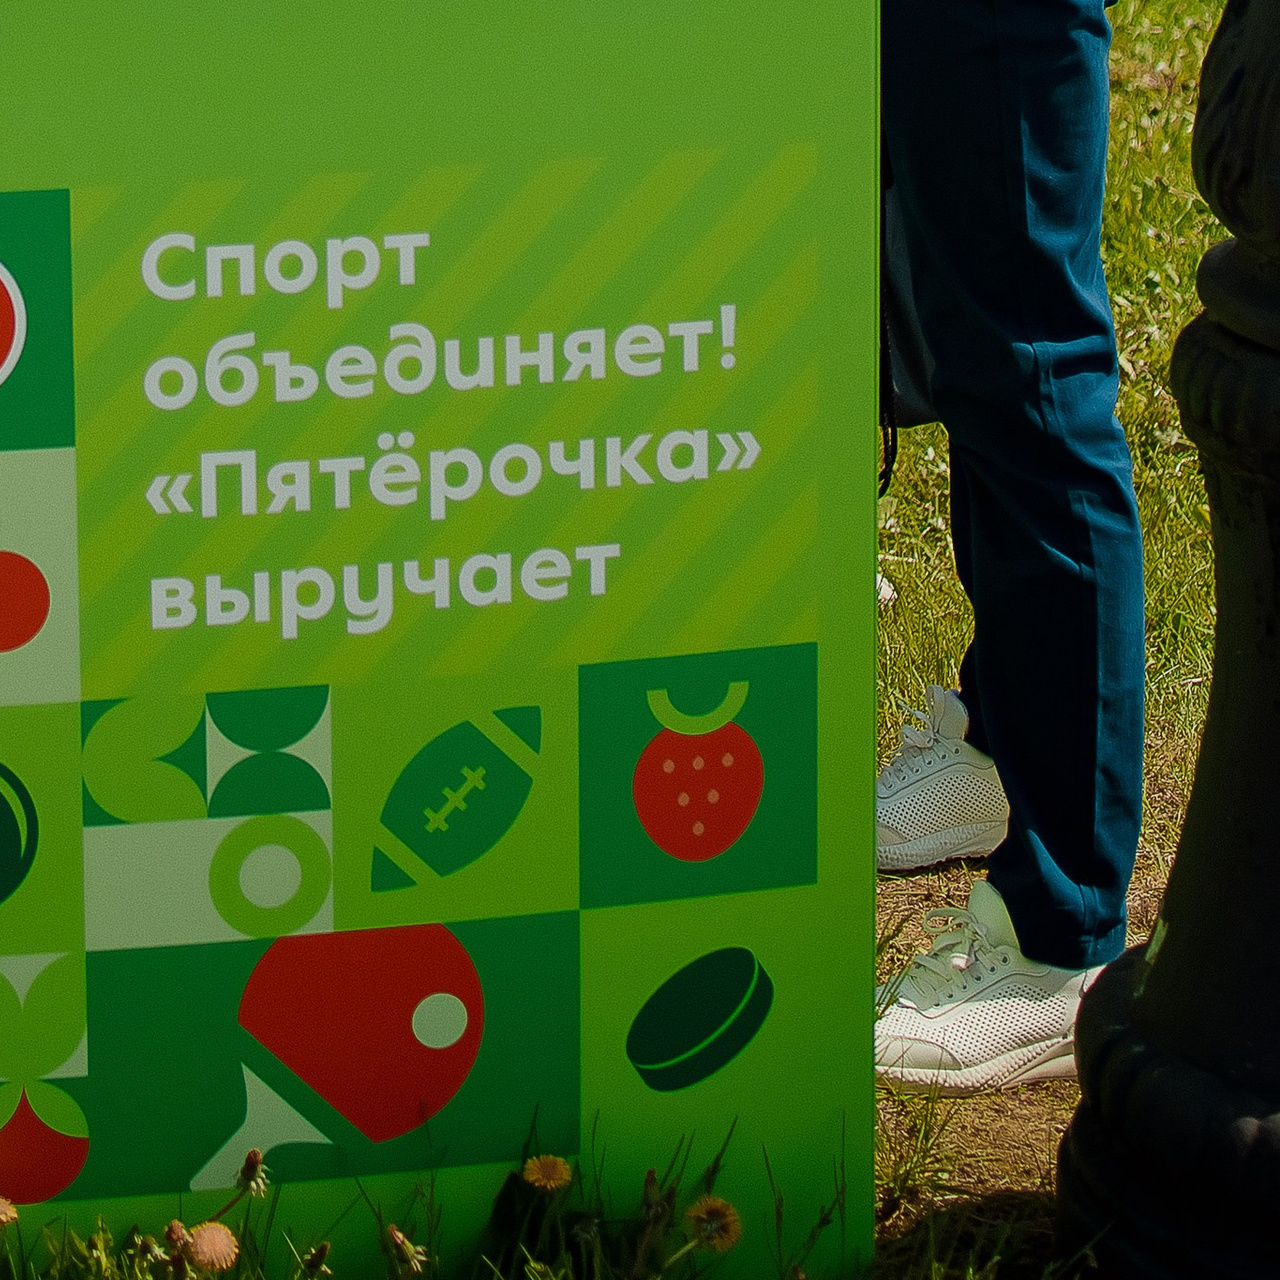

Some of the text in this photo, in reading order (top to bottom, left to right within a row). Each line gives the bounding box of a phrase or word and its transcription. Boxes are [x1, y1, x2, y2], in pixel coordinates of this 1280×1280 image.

[141, 232, 431, 309] Спорт
[143, 304, 738, 410] объединяет!
[145, 430, 762, 521] «Пятёрочка»
[150, 542, 621, 640] выручает
